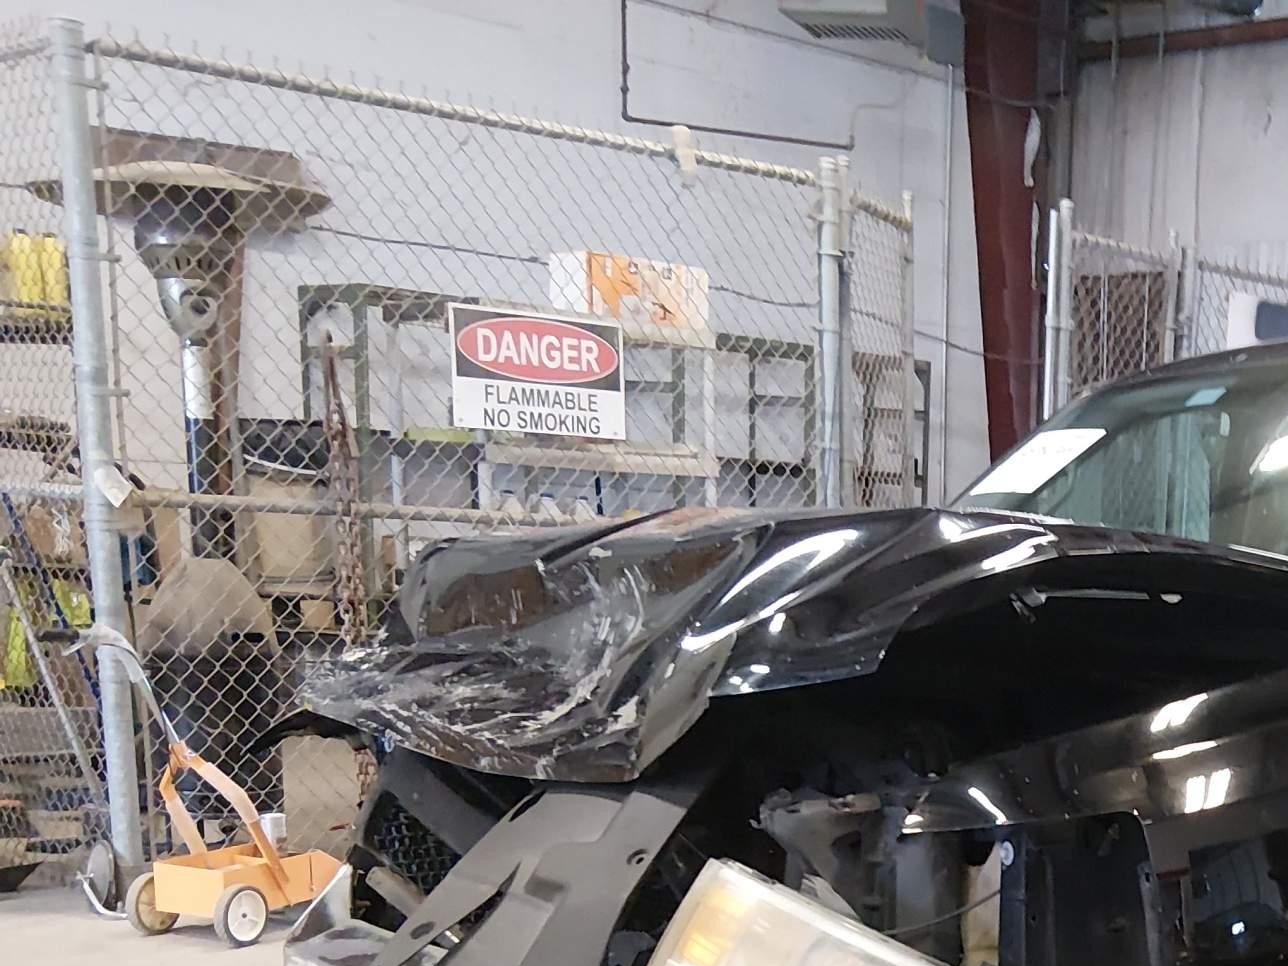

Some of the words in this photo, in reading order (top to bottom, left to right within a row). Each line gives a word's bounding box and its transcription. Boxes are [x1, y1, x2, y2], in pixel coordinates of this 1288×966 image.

[476, 327, 601, 373] DANGER
[484, 384, 598, 412] FLAMMABLE
[483, 408, 511, 427] NO
[517, 410, 600, 434] SMOKING
